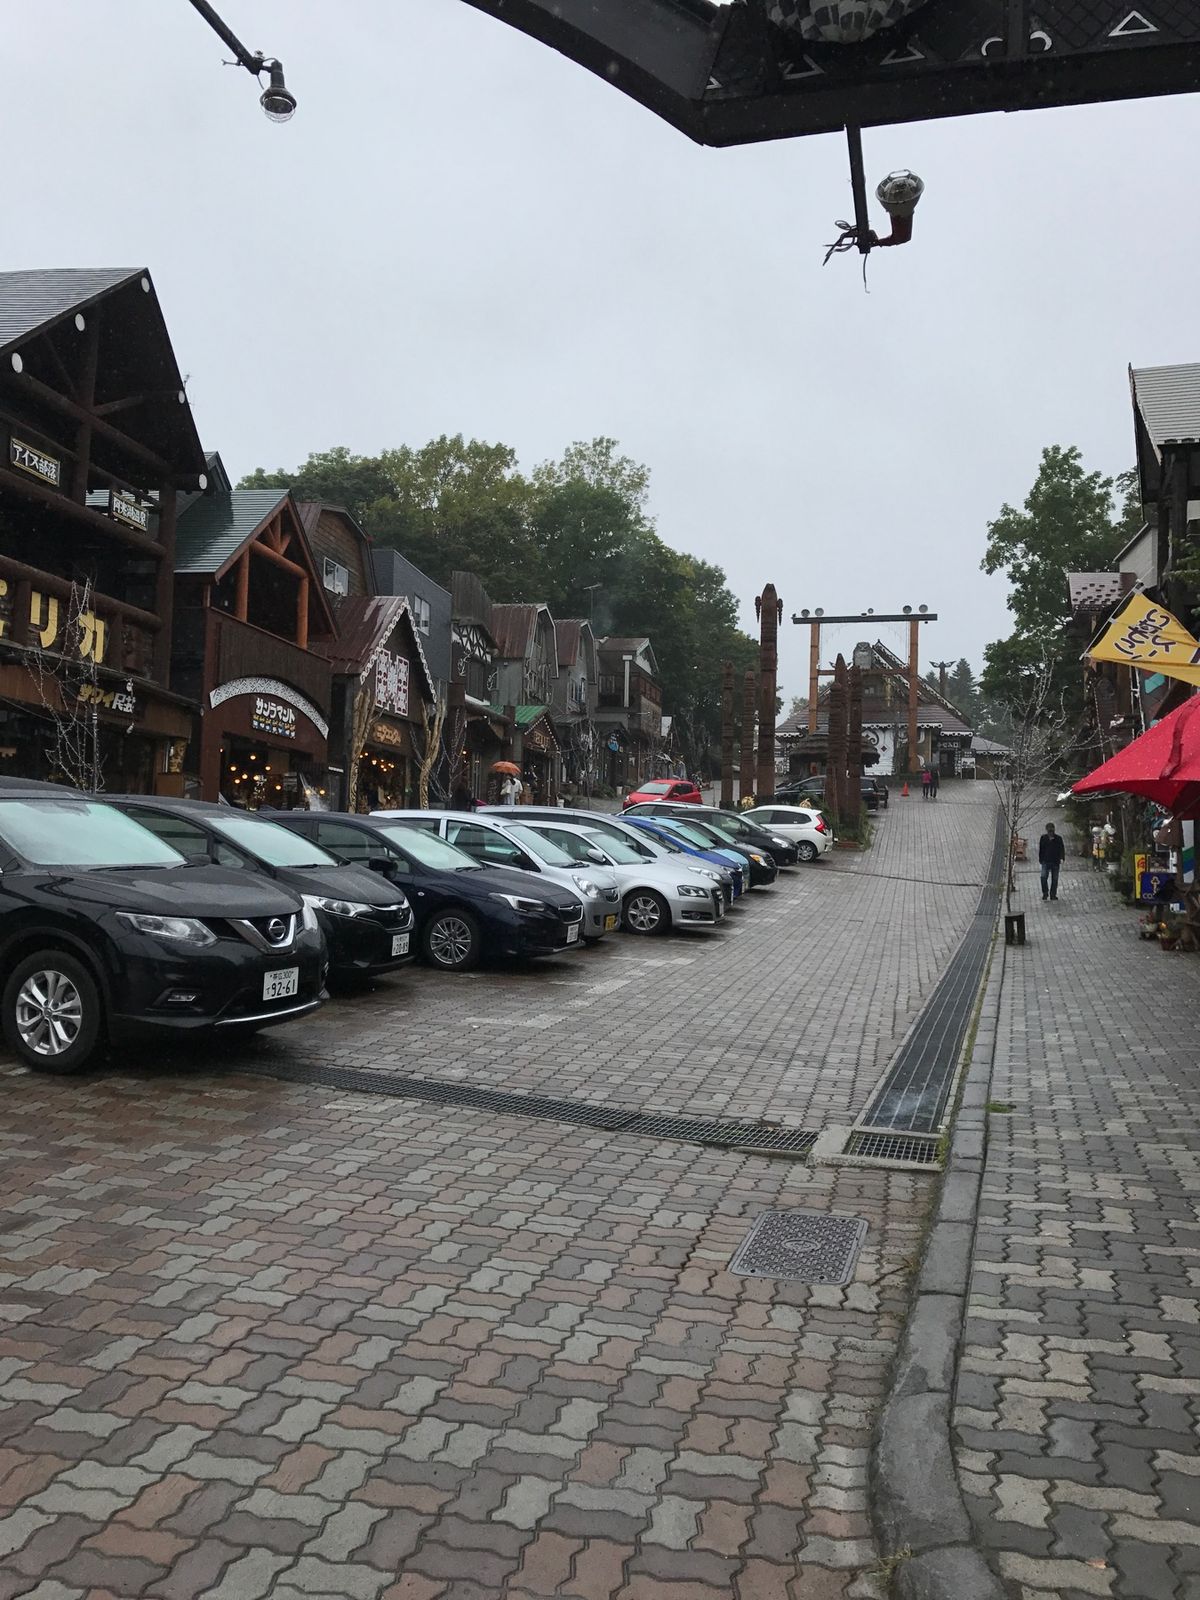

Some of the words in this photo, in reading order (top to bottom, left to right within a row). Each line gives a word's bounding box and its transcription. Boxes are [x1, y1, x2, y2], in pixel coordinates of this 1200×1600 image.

[12, 443, 57, 480] アイヌ部落
[271, 978, 296, 997] 92-61
